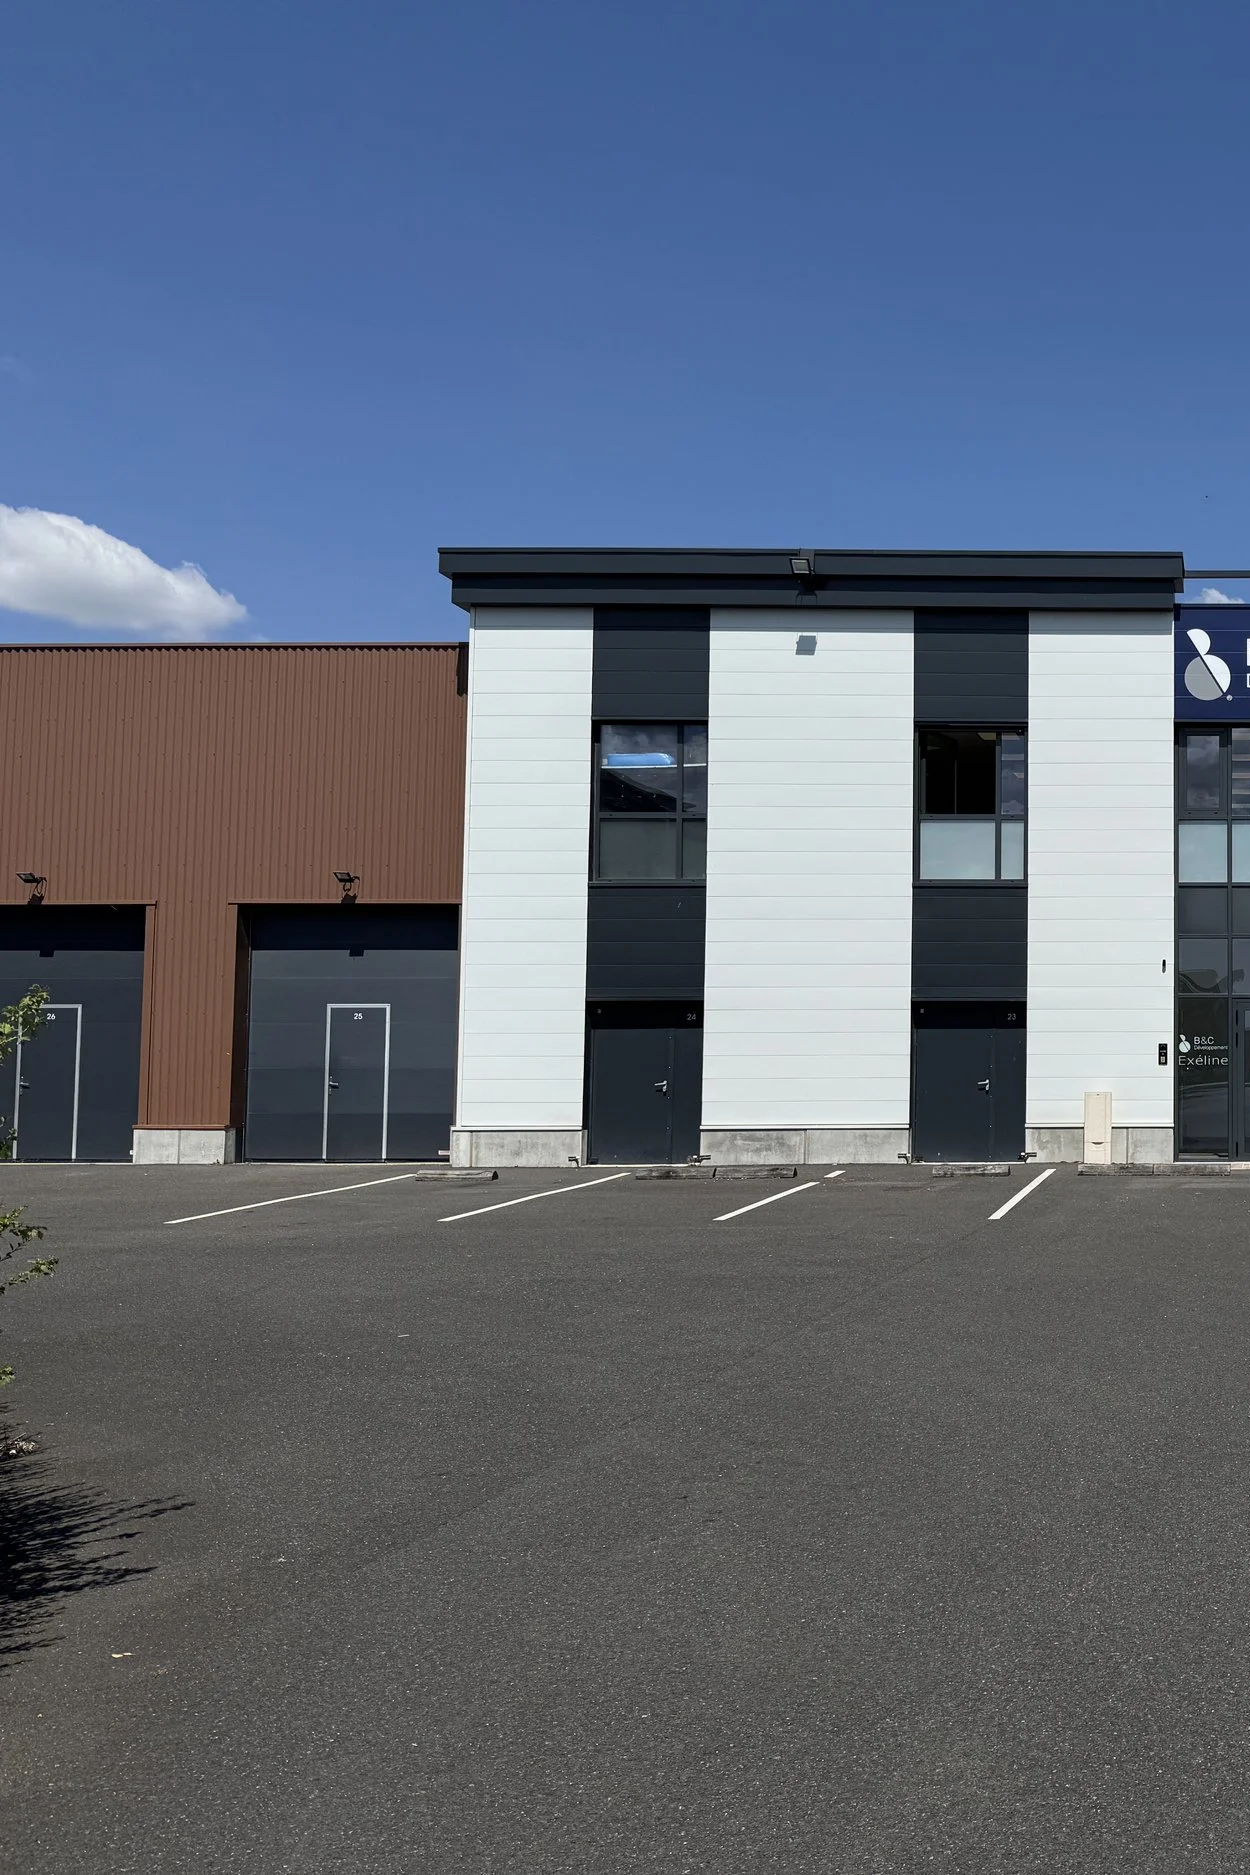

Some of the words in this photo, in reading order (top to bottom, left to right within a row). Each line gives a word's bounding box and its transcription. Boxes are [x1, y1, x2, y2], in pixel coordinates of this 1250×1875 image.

[353, 1012, 363, 1020] 25
[1194, 1036, 1214, 1045] B&C
[1179, 1054, 1228, 1065] Exéline
